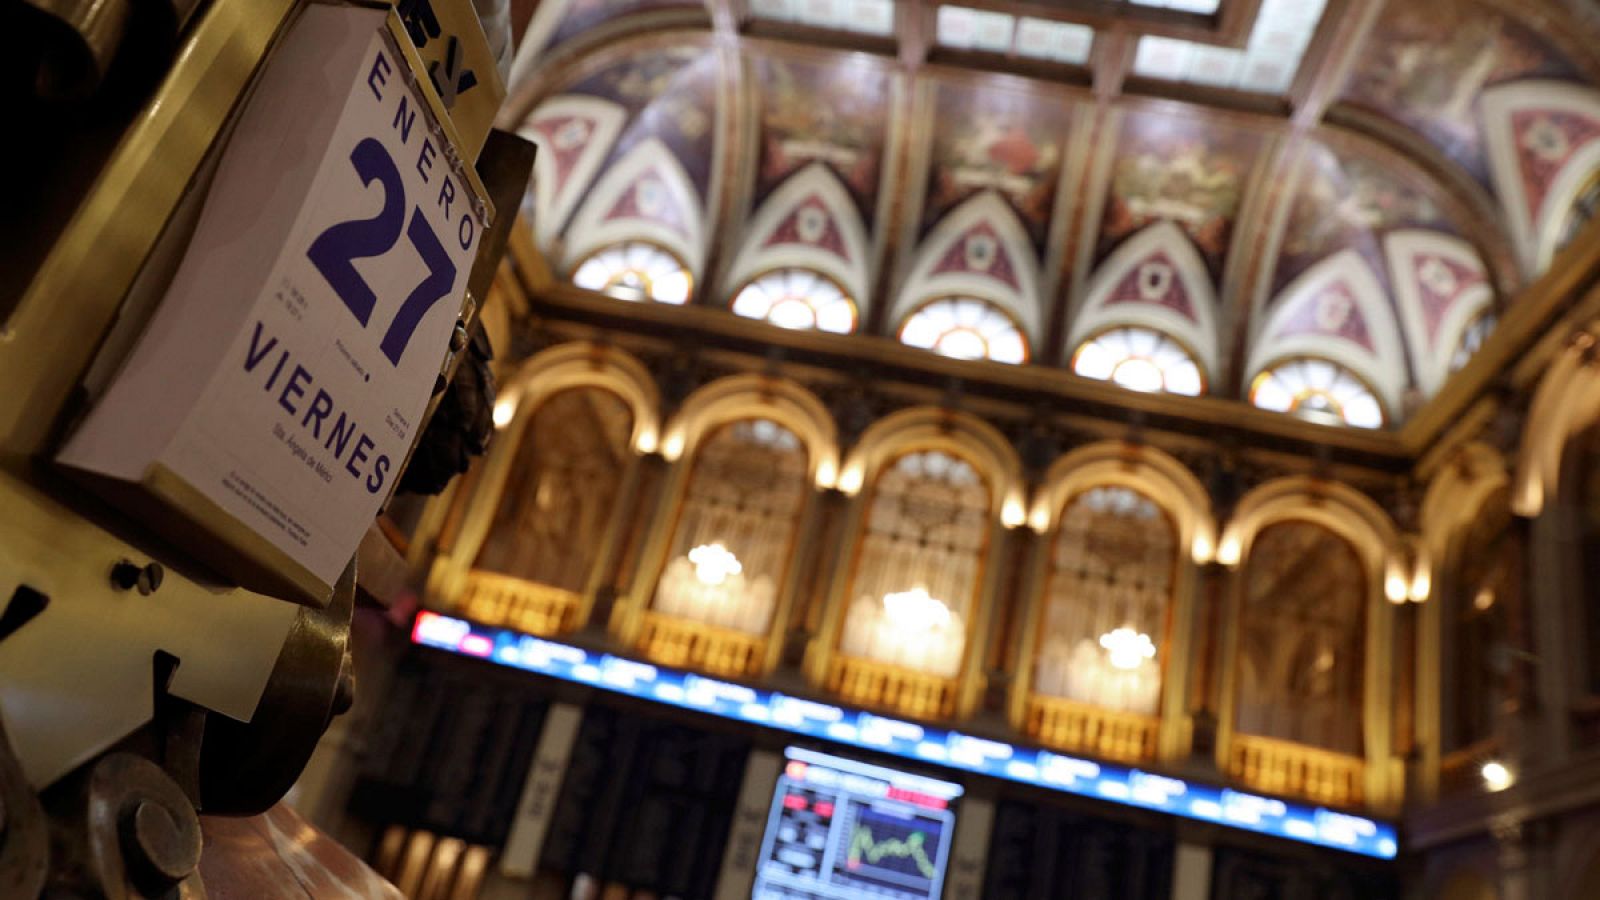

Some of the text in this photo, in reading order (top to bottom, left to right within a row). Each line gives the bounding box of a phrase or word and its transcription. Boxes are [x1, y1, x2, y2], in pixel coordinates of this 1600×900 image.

[367, 51, 474, 251] ENERO
[306, 136, 457, 368] 27
[243, 321, 390, 494] VIERNES
